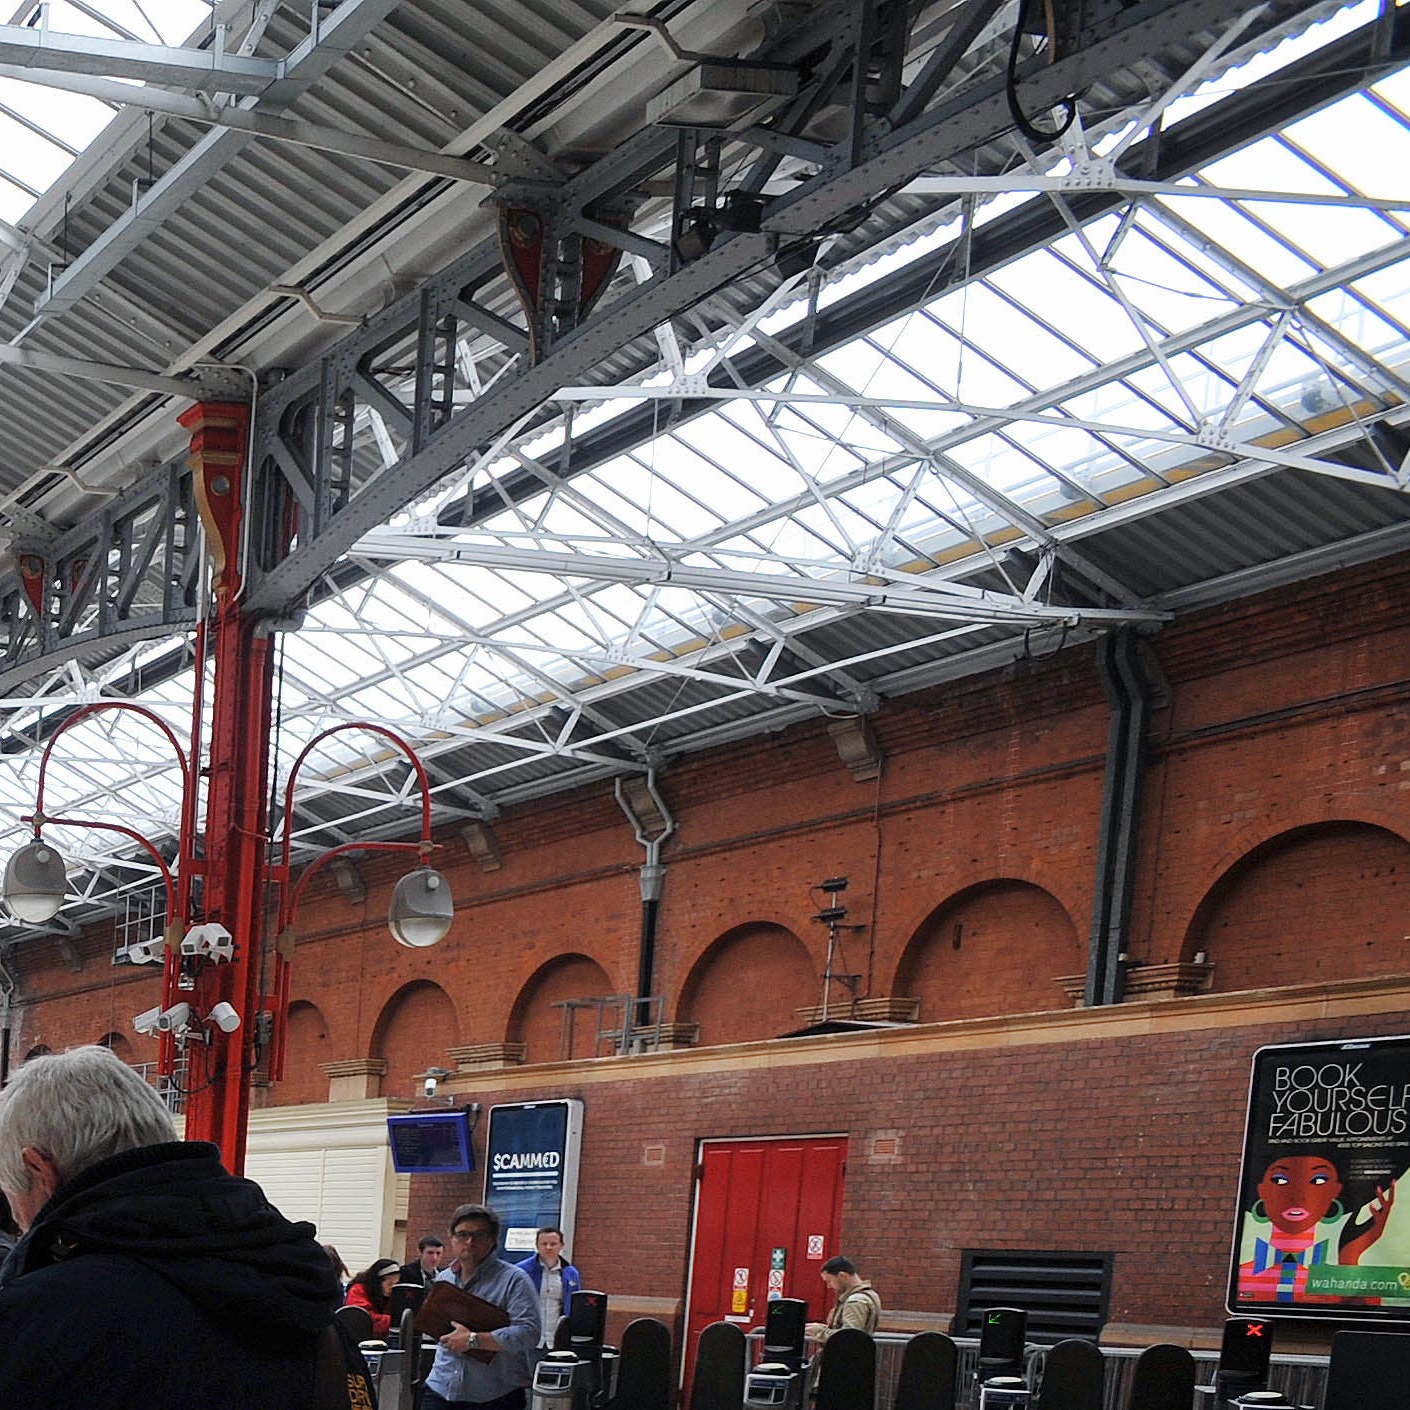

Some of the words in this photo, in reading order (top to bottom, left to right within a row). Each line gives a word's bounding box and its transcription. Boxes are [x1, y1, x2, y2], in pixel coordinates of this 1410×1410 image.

[1275, 1062, 1363, 1091] BOOK
[1268, 1108, 1408, 1137] FABULOUS
[1311, 1277, 1399, 1291] wahanda.com
